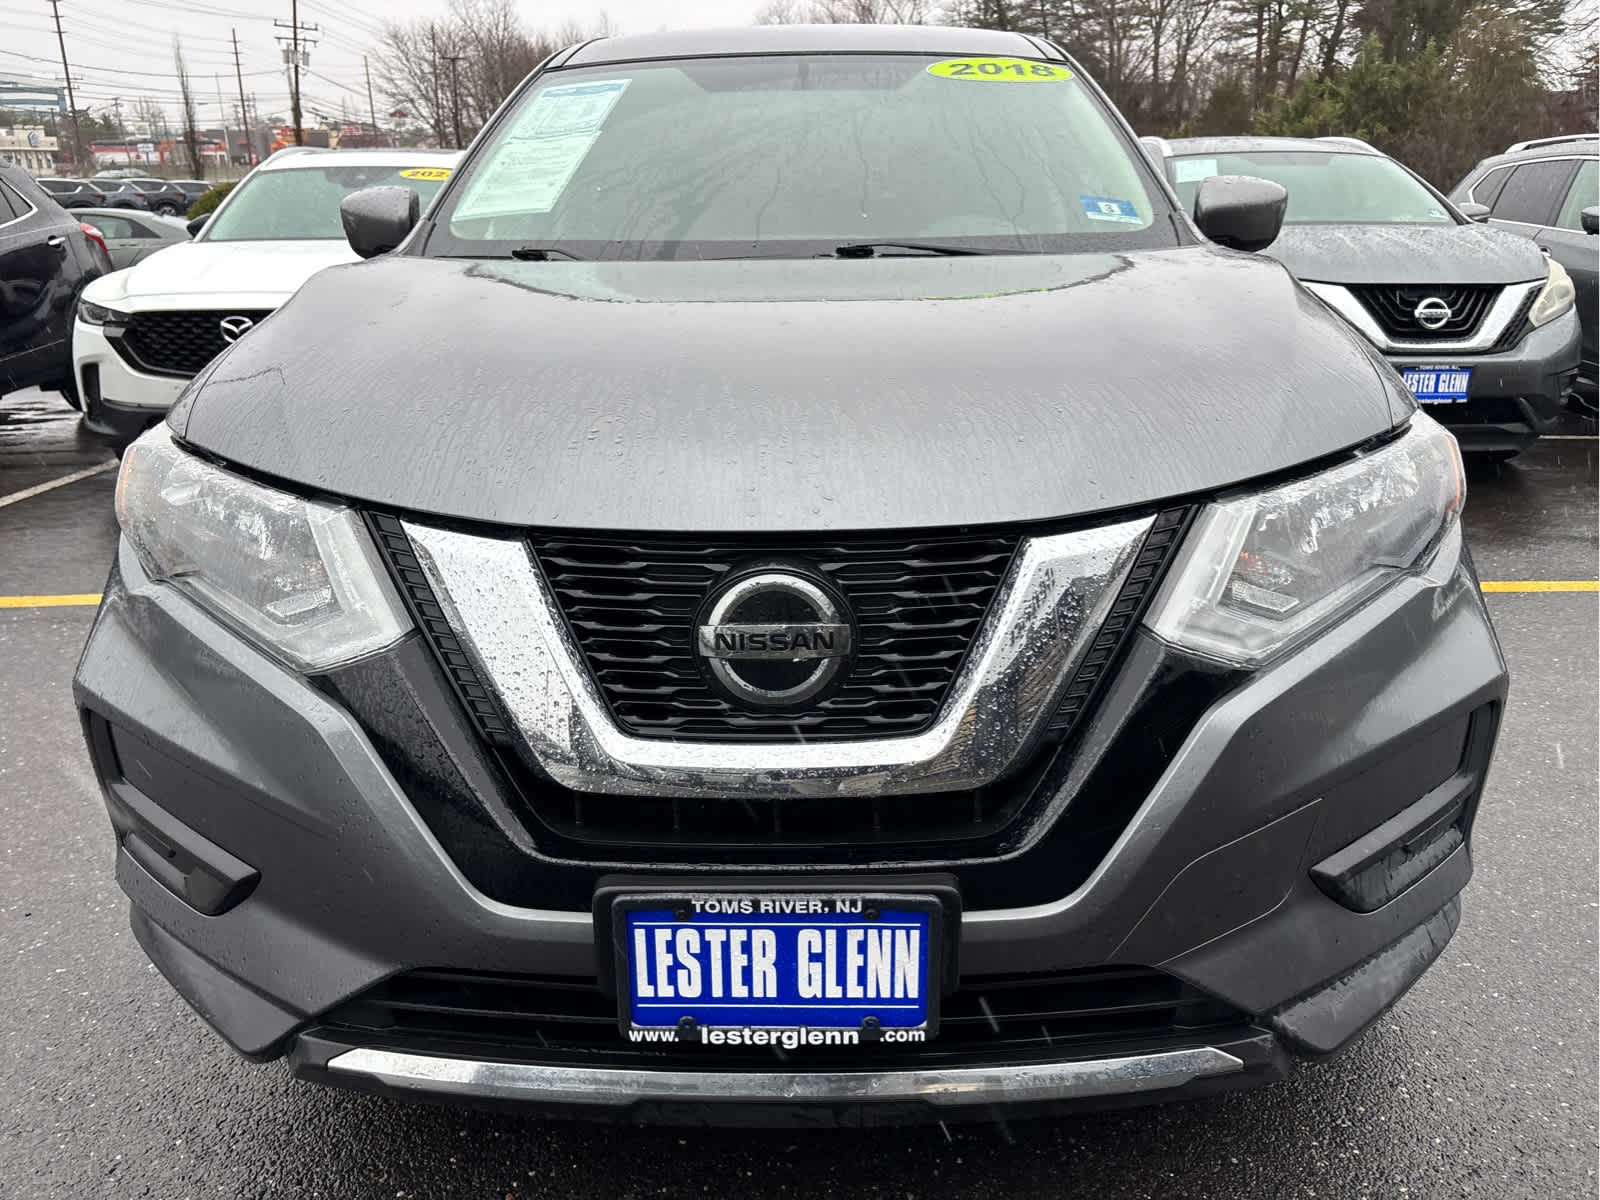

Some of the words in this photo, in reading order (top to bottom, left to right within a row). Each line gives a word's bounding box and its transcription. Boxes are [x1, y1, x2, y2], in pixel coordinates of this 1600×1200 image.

[948, 62, 1057, 77] 2018
[1438, 374, 1469, 392] GLENN
[714, 631, 834, 652] NISSAN
[692, 899, 753, 914] TOMS
[761, 900, 829, 914] RIVER,
[836, 900, 863, 914] NJ
[633, 928, 777, 998] LESTER
[797, 928, 920, 999] GLENN
[628, 1029, 679, 1042] www.
[701, 1027, 859, 1049] lesterglenn
[879, 1028, 926, 1043] .com
